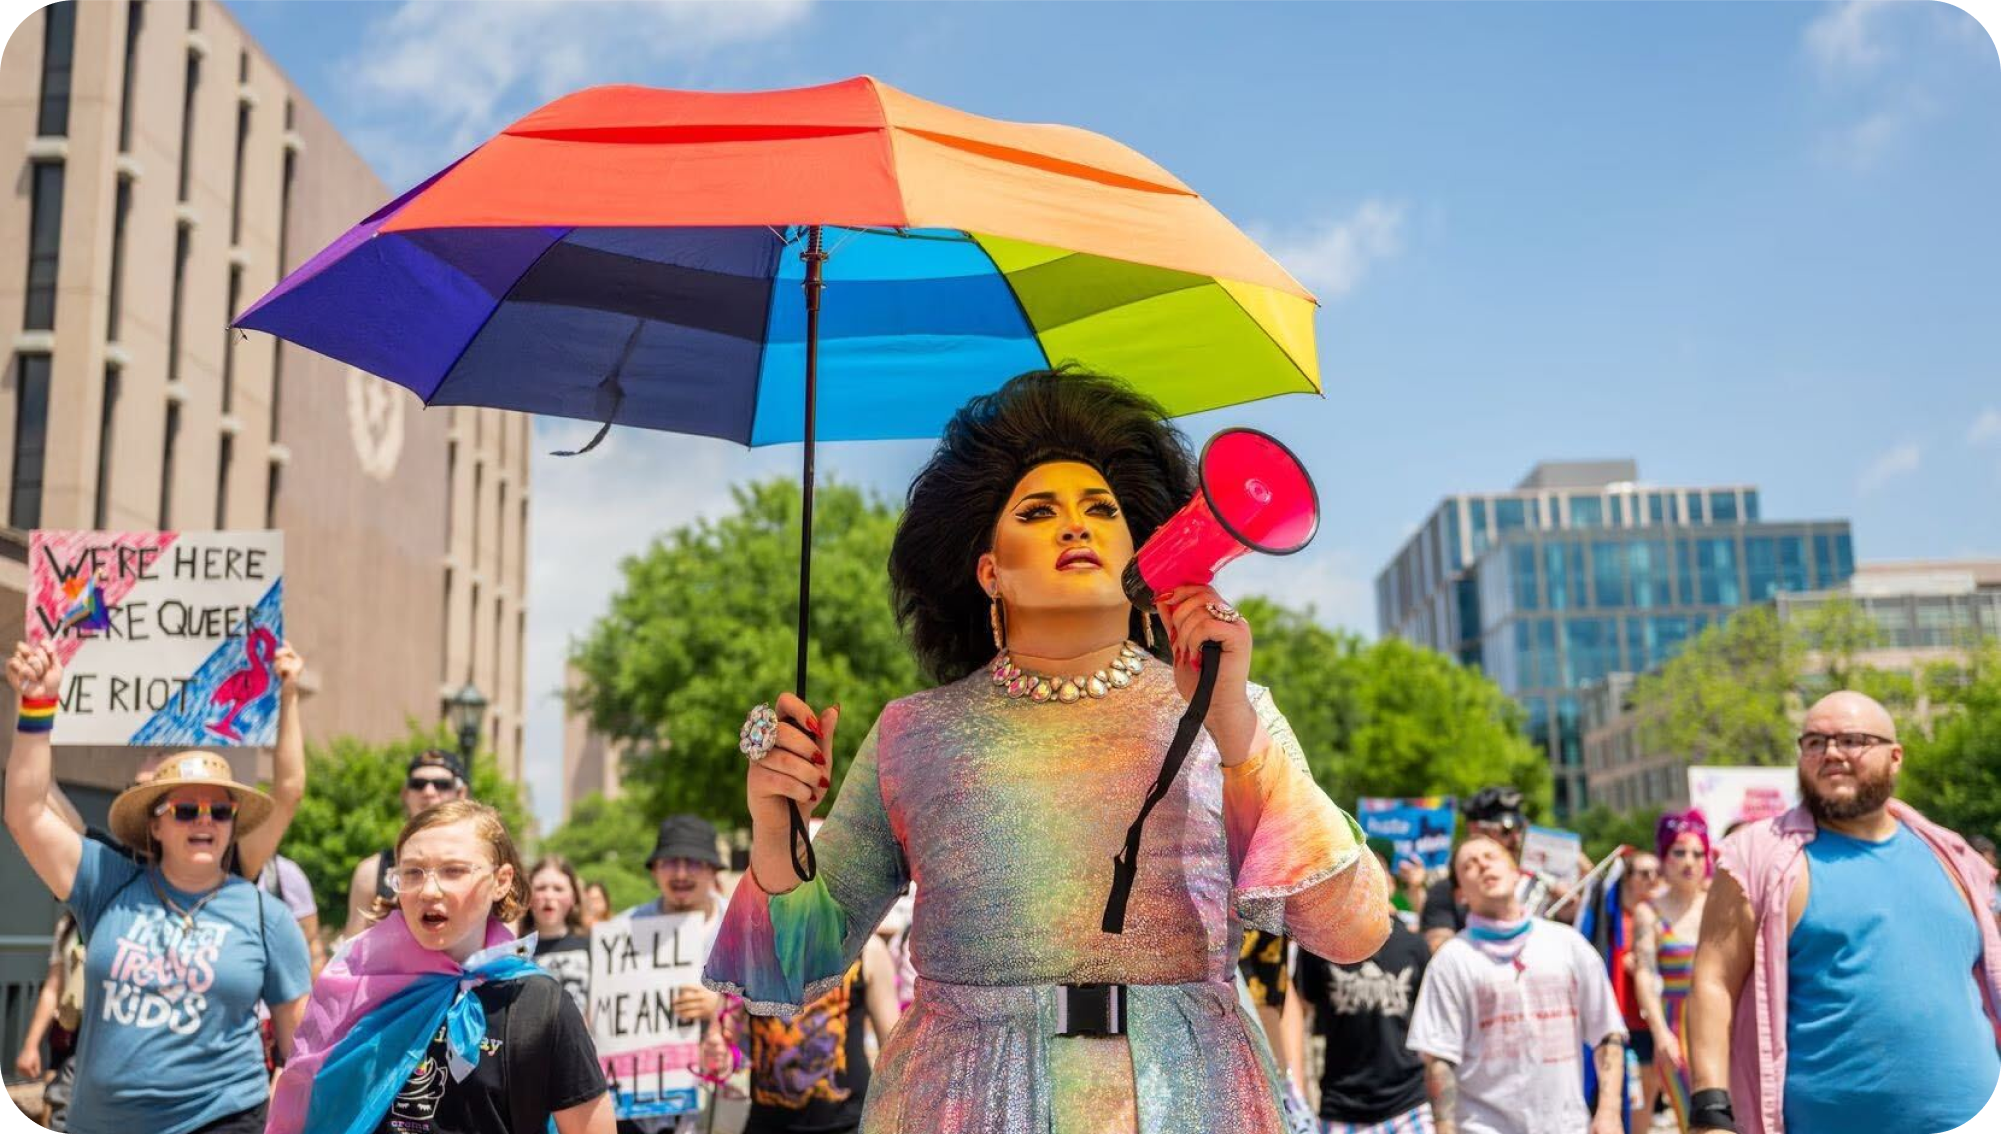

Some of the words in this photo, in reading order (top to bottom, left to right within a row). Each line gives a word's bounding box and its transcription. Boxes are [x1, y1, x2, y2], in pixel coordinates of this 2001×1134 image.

[43, 543, 159, 583] WE'RE
[174, 547, 266, 580] HERE
[158, 600, 260, 637] QUEER
[110, 676, 198, 713] RIOT
[604, 1052, 685, 1107] ALL
